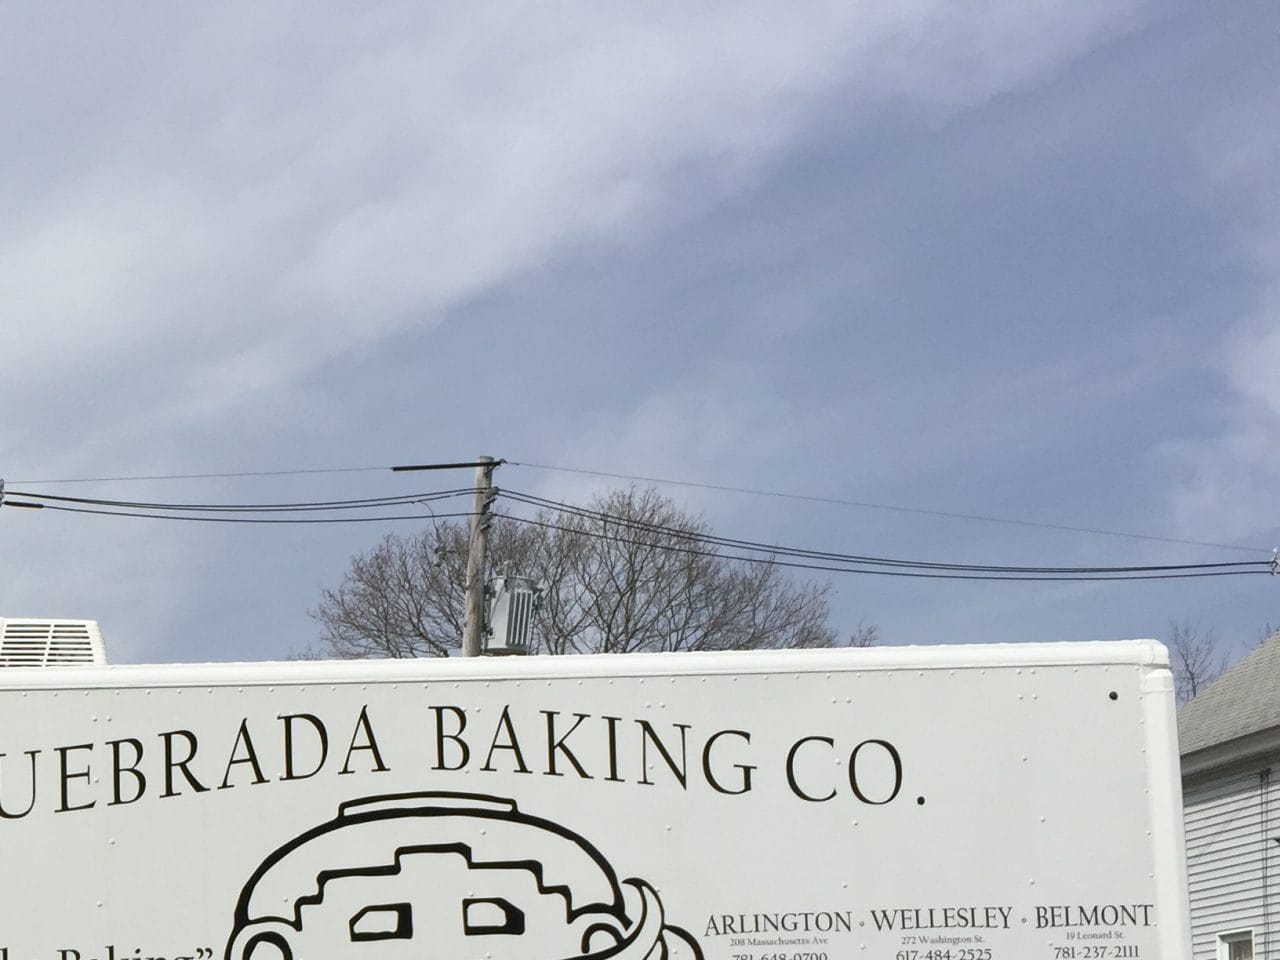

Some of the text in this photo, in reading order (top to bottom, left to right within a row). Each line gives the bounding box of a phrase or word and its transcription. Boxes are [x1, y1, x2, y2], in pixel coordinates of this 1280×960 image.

[427, 704, 759, 796] BAKING
[785, 736, 926, 807] CO.
[704, 904, 1154, 937] ARLINGTON WELLESLEY BELMONT
[747, 936, 809, 946] Massachusetts
[901, 936, 917, 945] 272
[919, 935, 972, 946] Washington
[1066, 932, 1075, 940] 19
[1077, 931, 1112, 940] Leonard
[1054, 945, 1139, 960] 781-237-2111
